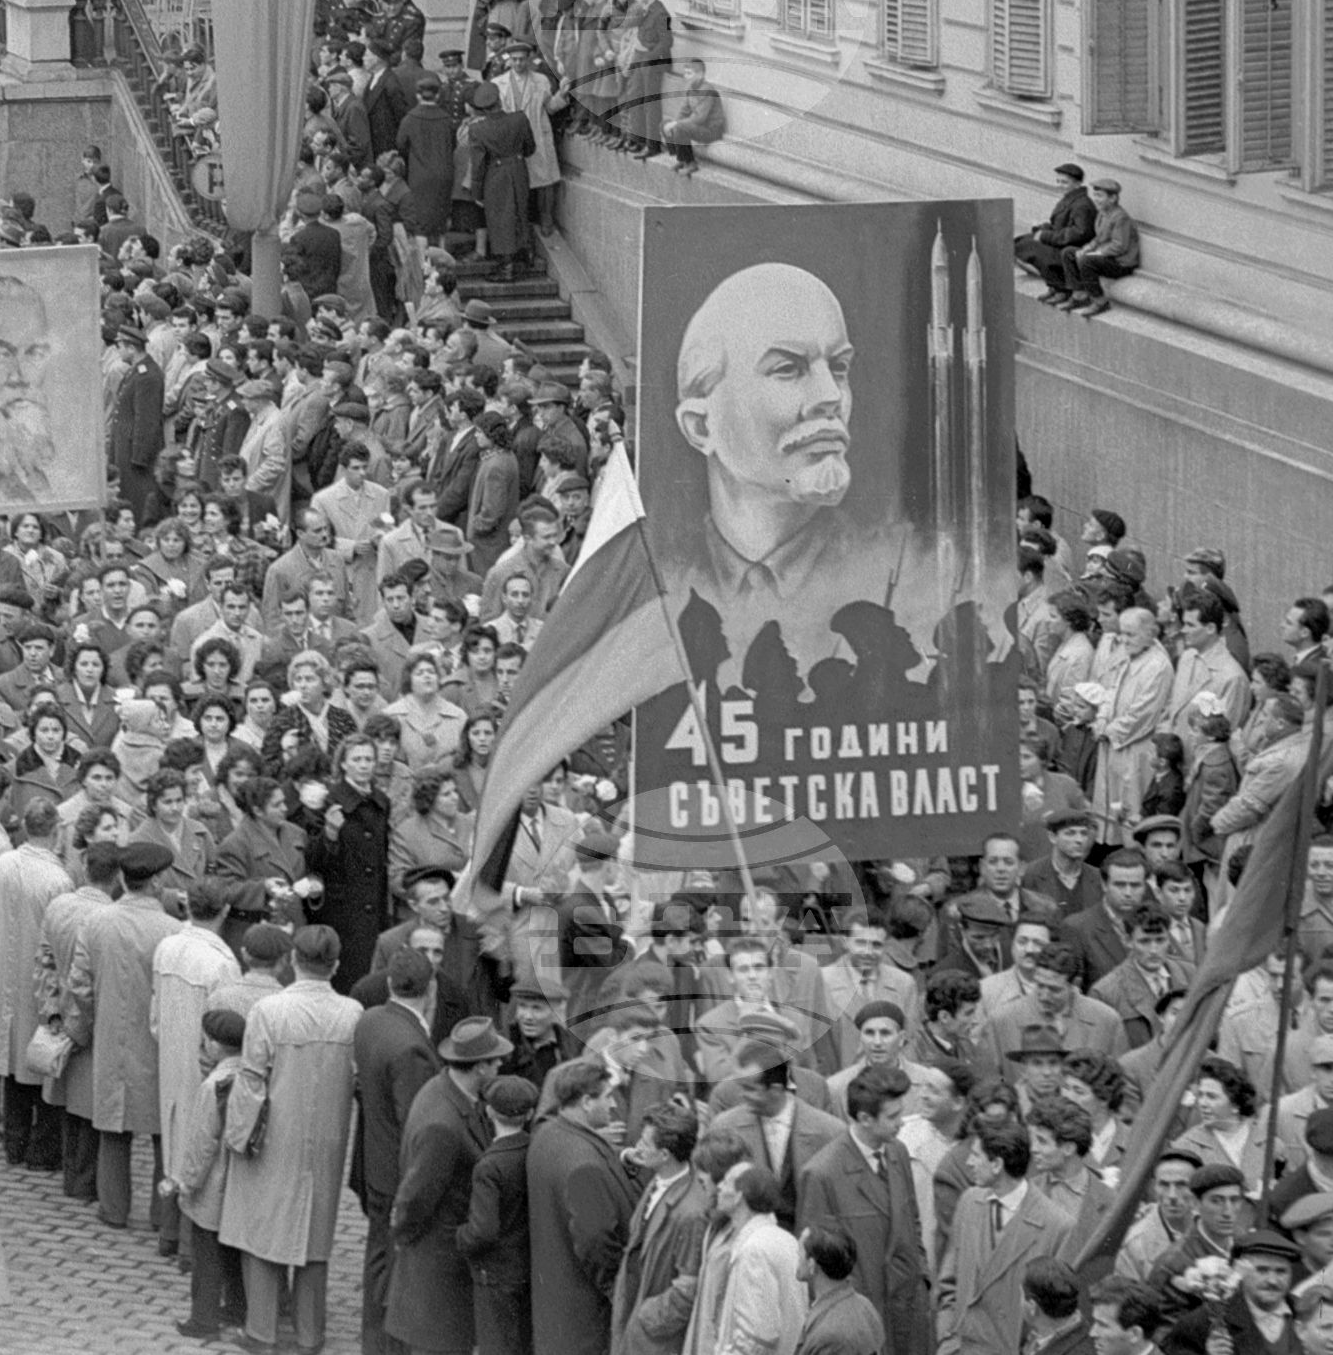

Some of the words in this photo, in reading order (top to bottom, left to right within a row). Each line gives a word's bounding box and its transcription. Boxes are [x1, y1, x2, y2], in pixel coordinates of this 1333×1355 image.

[664, 678, 759, 766] 45
[784, 719, 949, 761] ГОДИНИ
[669, 770, 881, 828] СЪВЕТСКА
[889, 764, 1001, 817] ВЛАСТ
